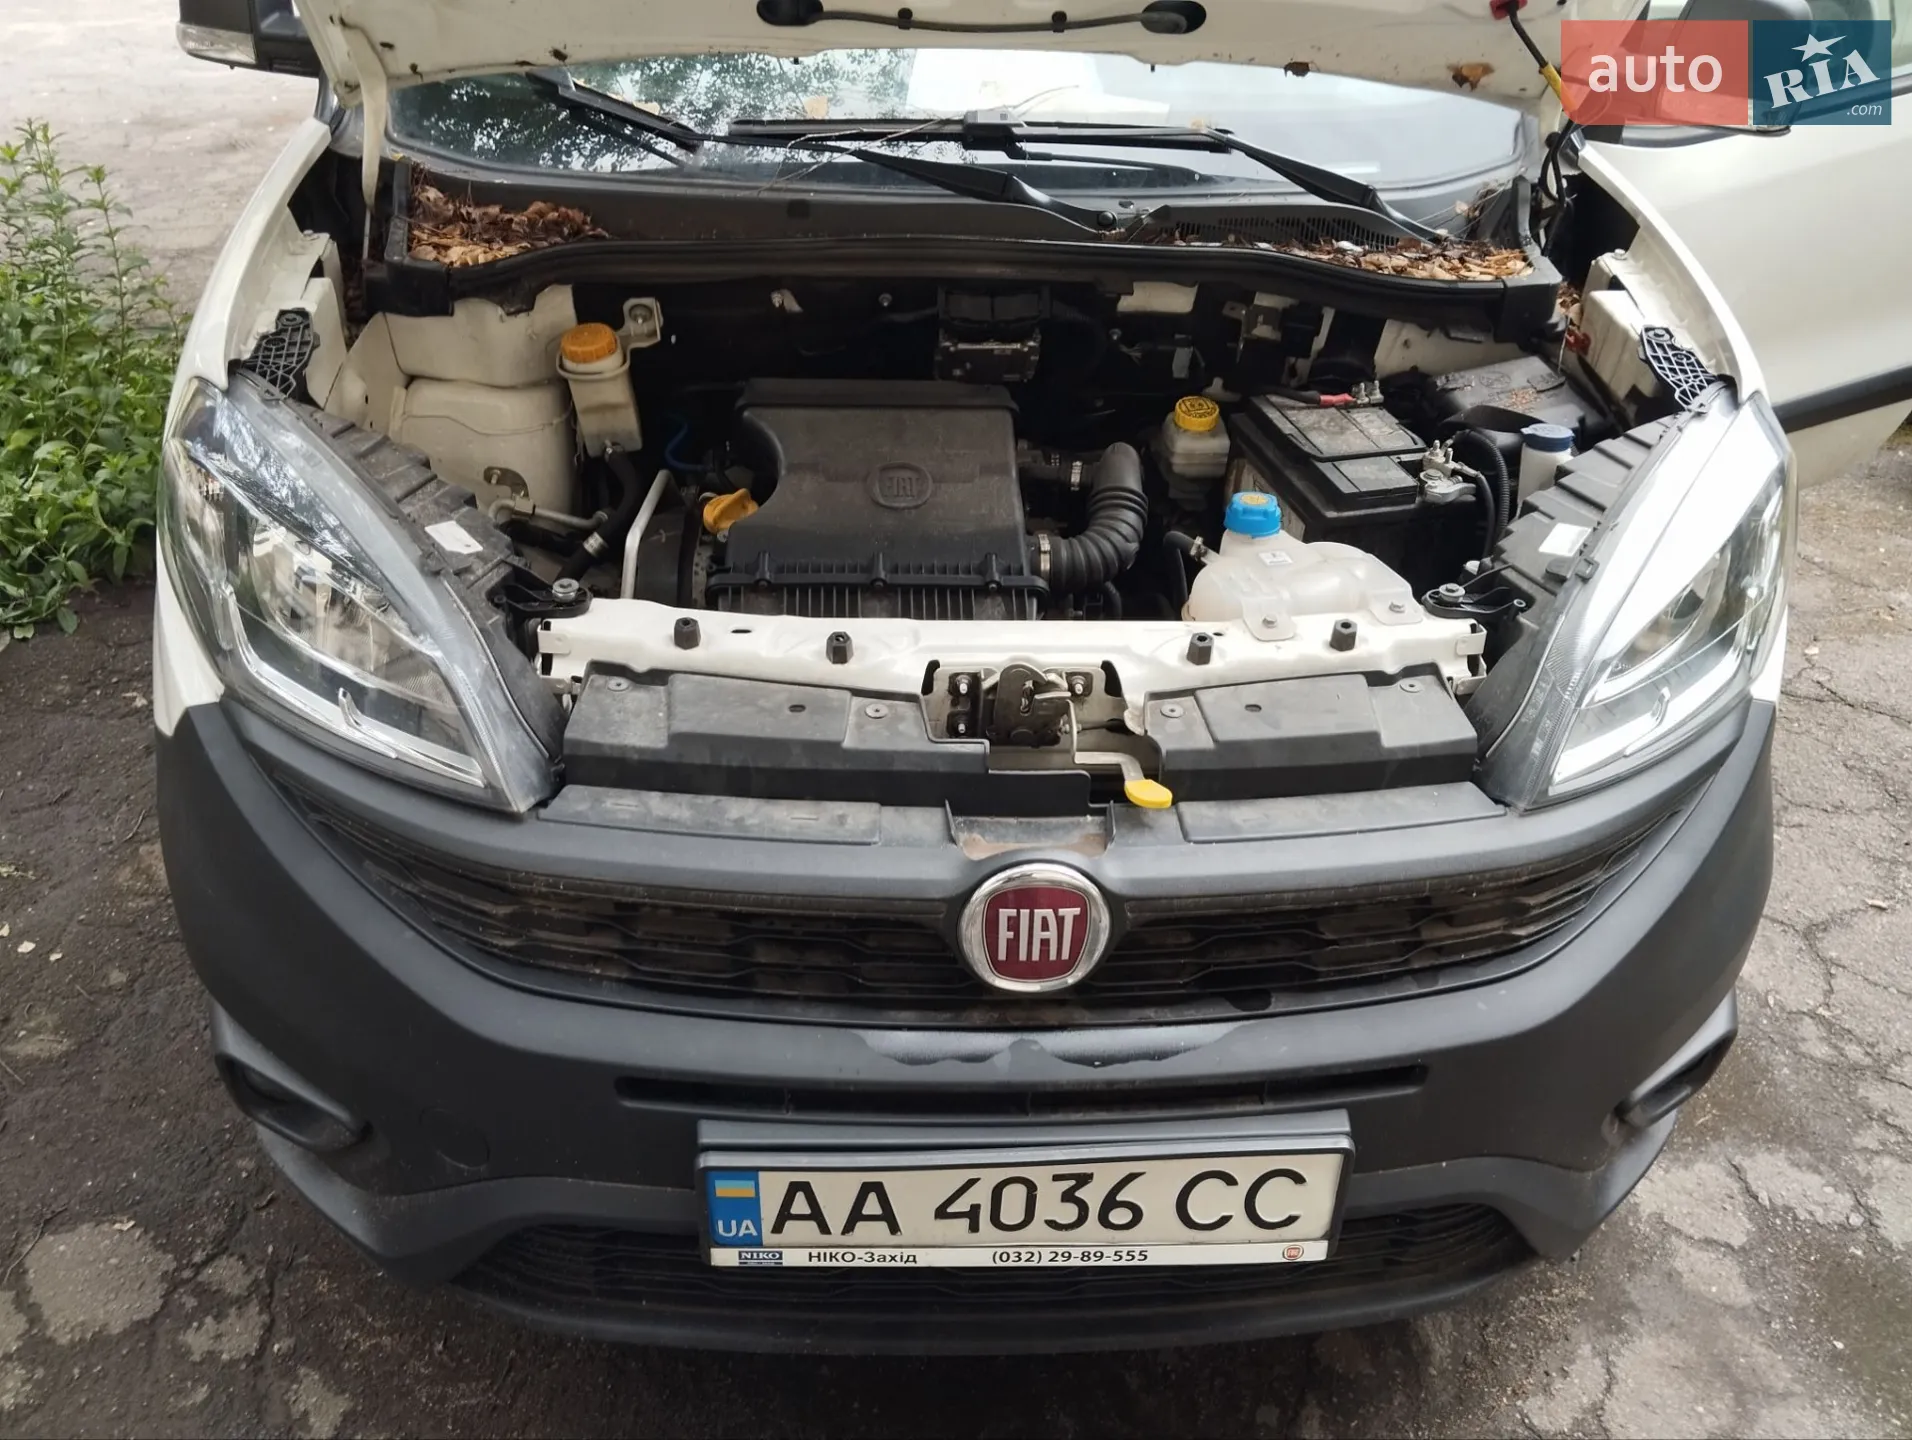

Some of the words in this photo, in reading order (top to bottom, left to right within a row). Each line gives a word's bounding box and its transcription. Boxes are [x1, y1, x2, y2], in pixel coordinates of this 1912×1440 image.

[998, 907, 1081, 962] FIAT
[770, 1180, 903, 1236] AA
[934, 1171, 1147, 1234] 4036
[1175, 1168, 1307, 1231] CC
[717, 1219, 759, 1237] UA
[740, 1251, 780, 1260] NIKO
[808, 1251, 918, 1265] НІКО-Захід
[992, 1250, 1043, 1265] (032)
[1047, 1250, 1149, 1263] 29-89-555
